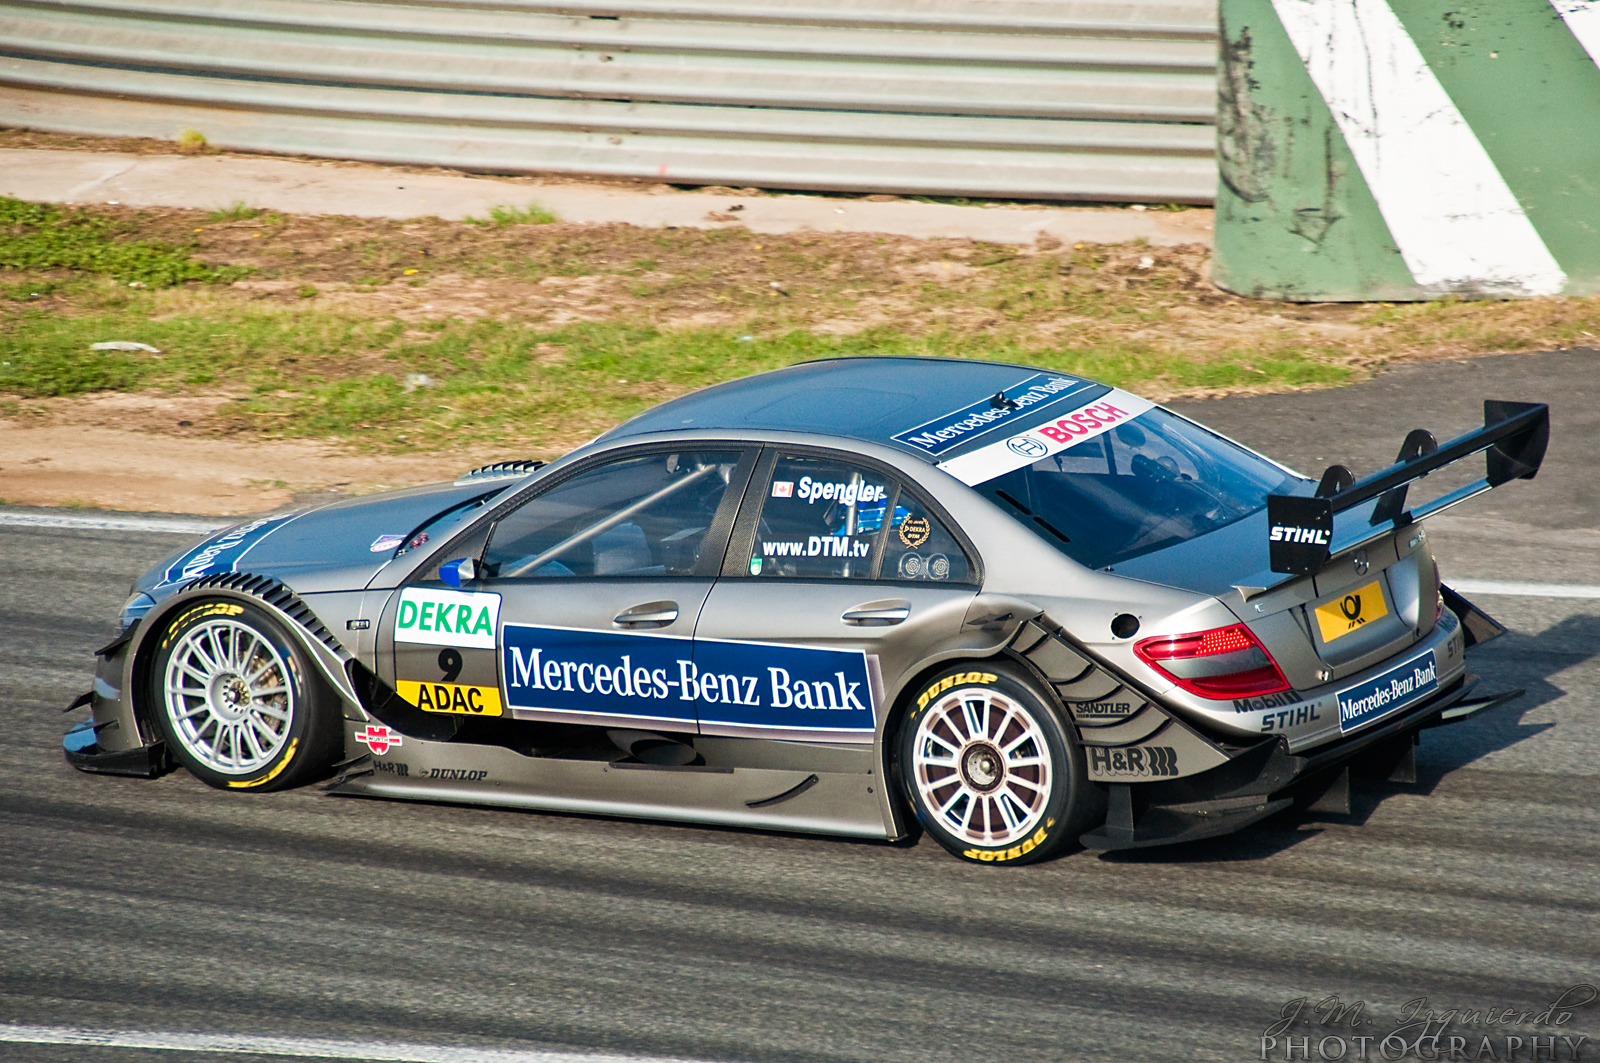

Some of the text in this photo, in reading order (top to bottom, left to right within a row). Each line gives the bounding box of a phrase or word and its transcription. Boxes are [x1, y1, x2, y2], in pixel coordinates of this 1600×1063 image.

[1028, 377, 1079, 395] Bank
[1038, 401, 1130, 444] BOSCH
[797, 476, 885, 506] Spengler
[763, 536, 870, 558] www.DTM.tv
[1269, 526, 1328, 545] STIHL
[397, 600, 494, 637] DEKRA
[437, 648, 463, 682] 9
[509, 646, 866, 711] Mercedes-Benz Bank
[417, 684, 484, 713] ADAC
[916, 672, 998, 712] DUNLOP
[1233, 692, 1287, 714] Mobil
[1341, 661, 1436, 722] Mercedes-Benz Bank
[1076, 702, 1131, 714] SANDTLER
[1261, 704, 1320, 732] STIHL
[373, 760, 395, 774] H&R
[429, 768, 488, 780] DUNLOP
[1090, 746, 1147, 774] H&R
[963, 826, 1049, 862] DUNLOP
